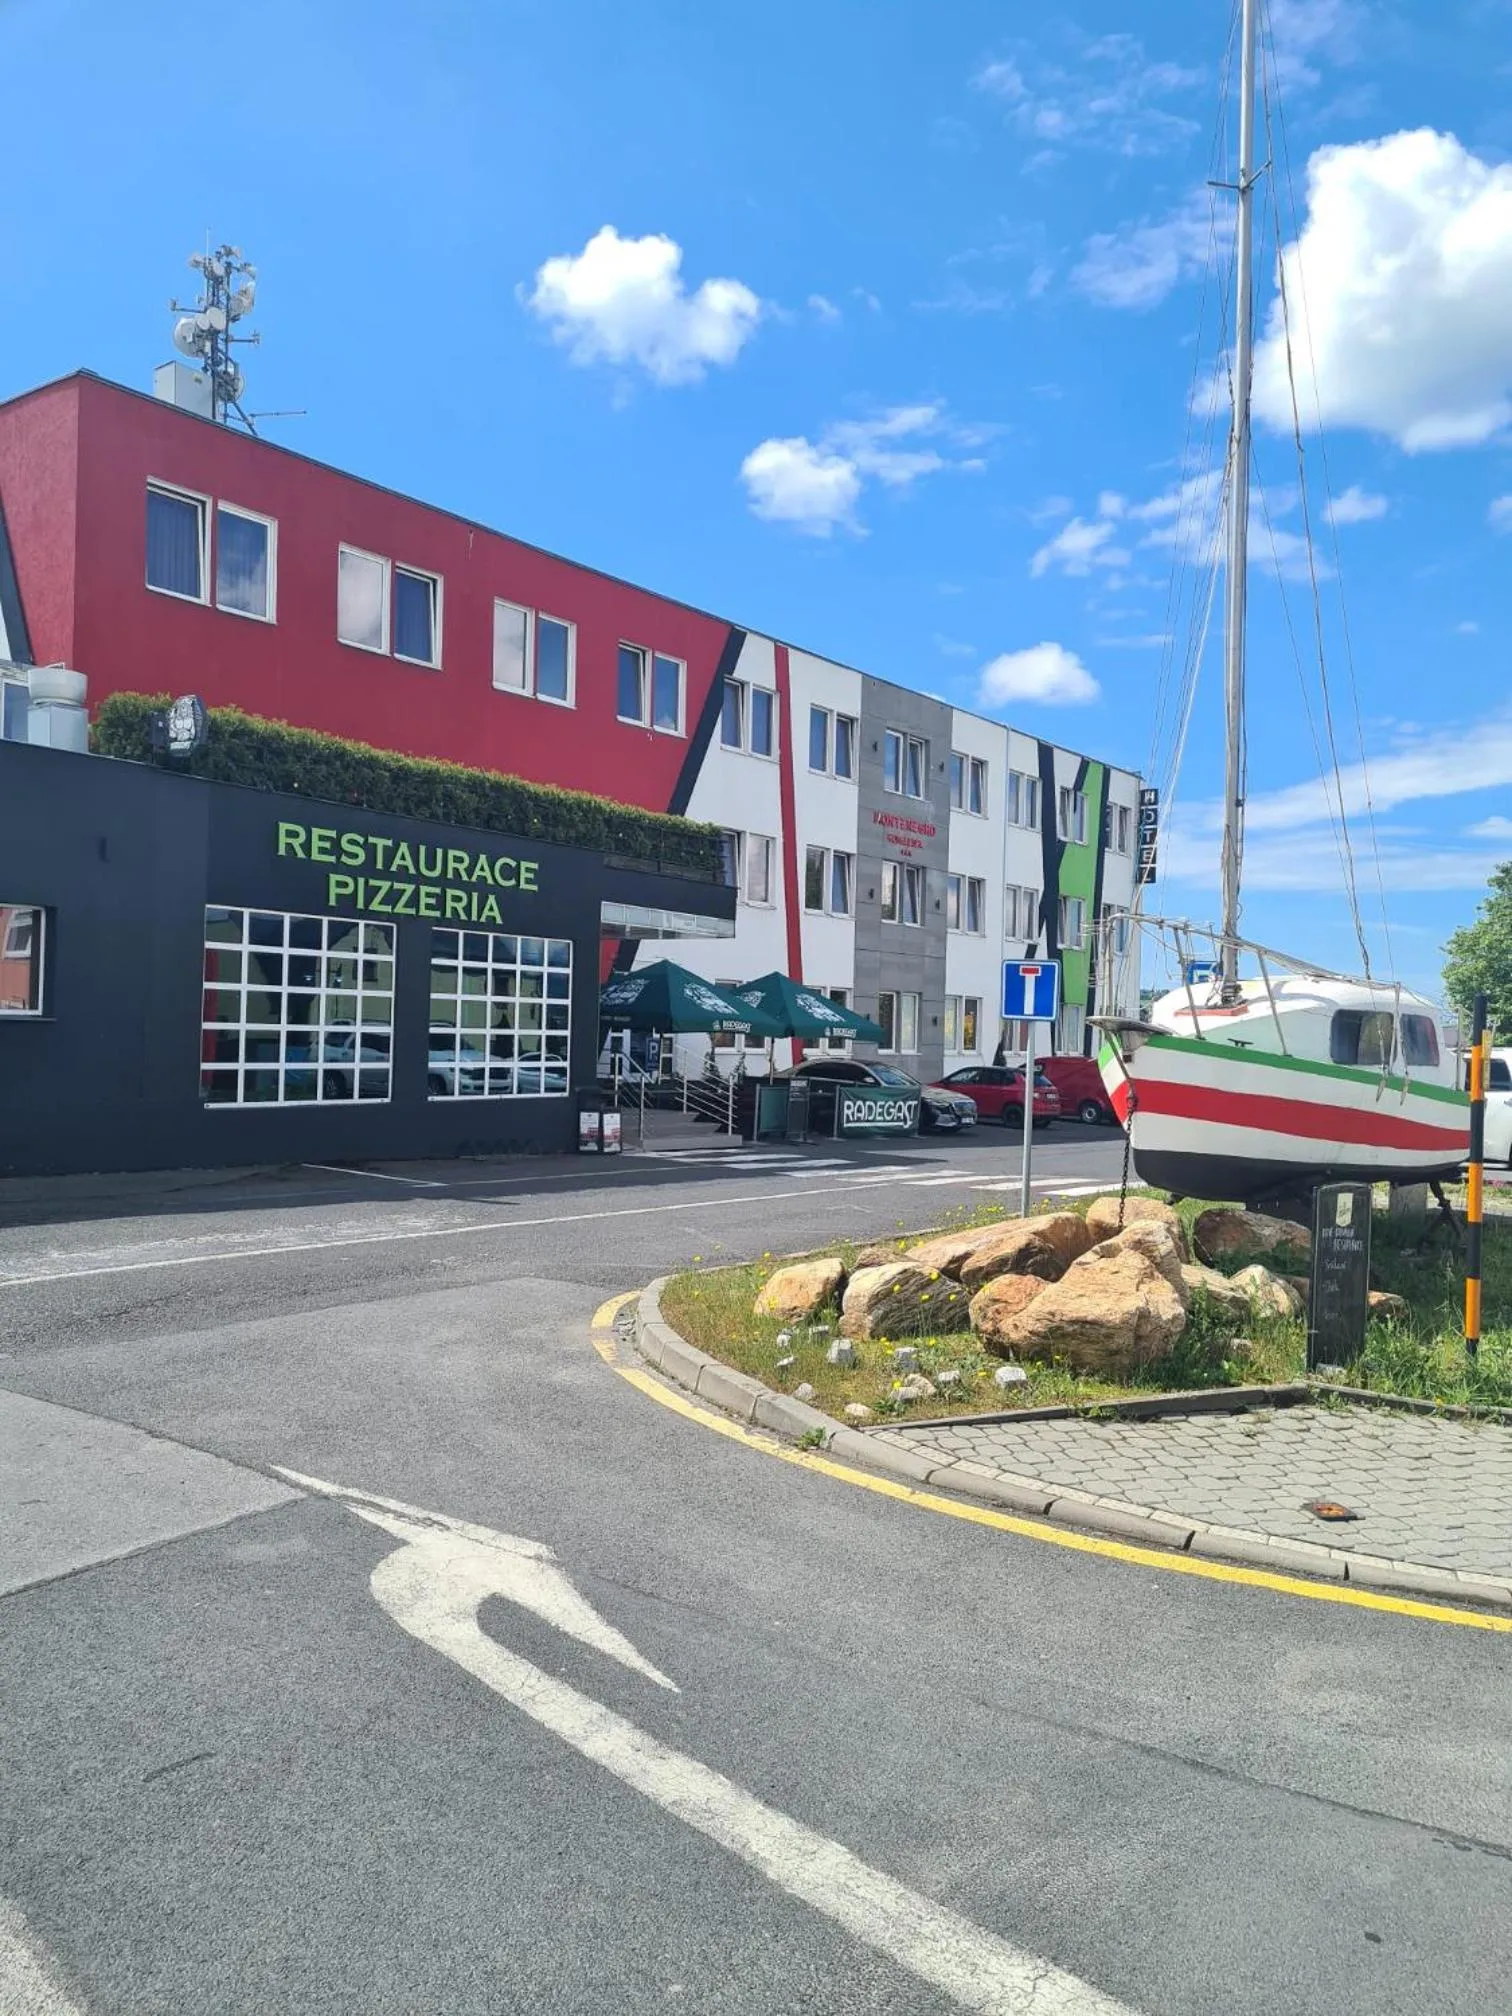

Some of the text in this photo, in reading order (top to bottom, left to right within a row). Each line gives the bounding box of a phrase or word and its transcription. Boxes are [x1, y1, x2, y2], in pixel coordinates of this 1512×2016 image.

[276, 821, 540, 892] RESTAURACE
[327, 873, 503, 925] PIZZERIA
[843, 1100, 919, 1129] RADEGAST
